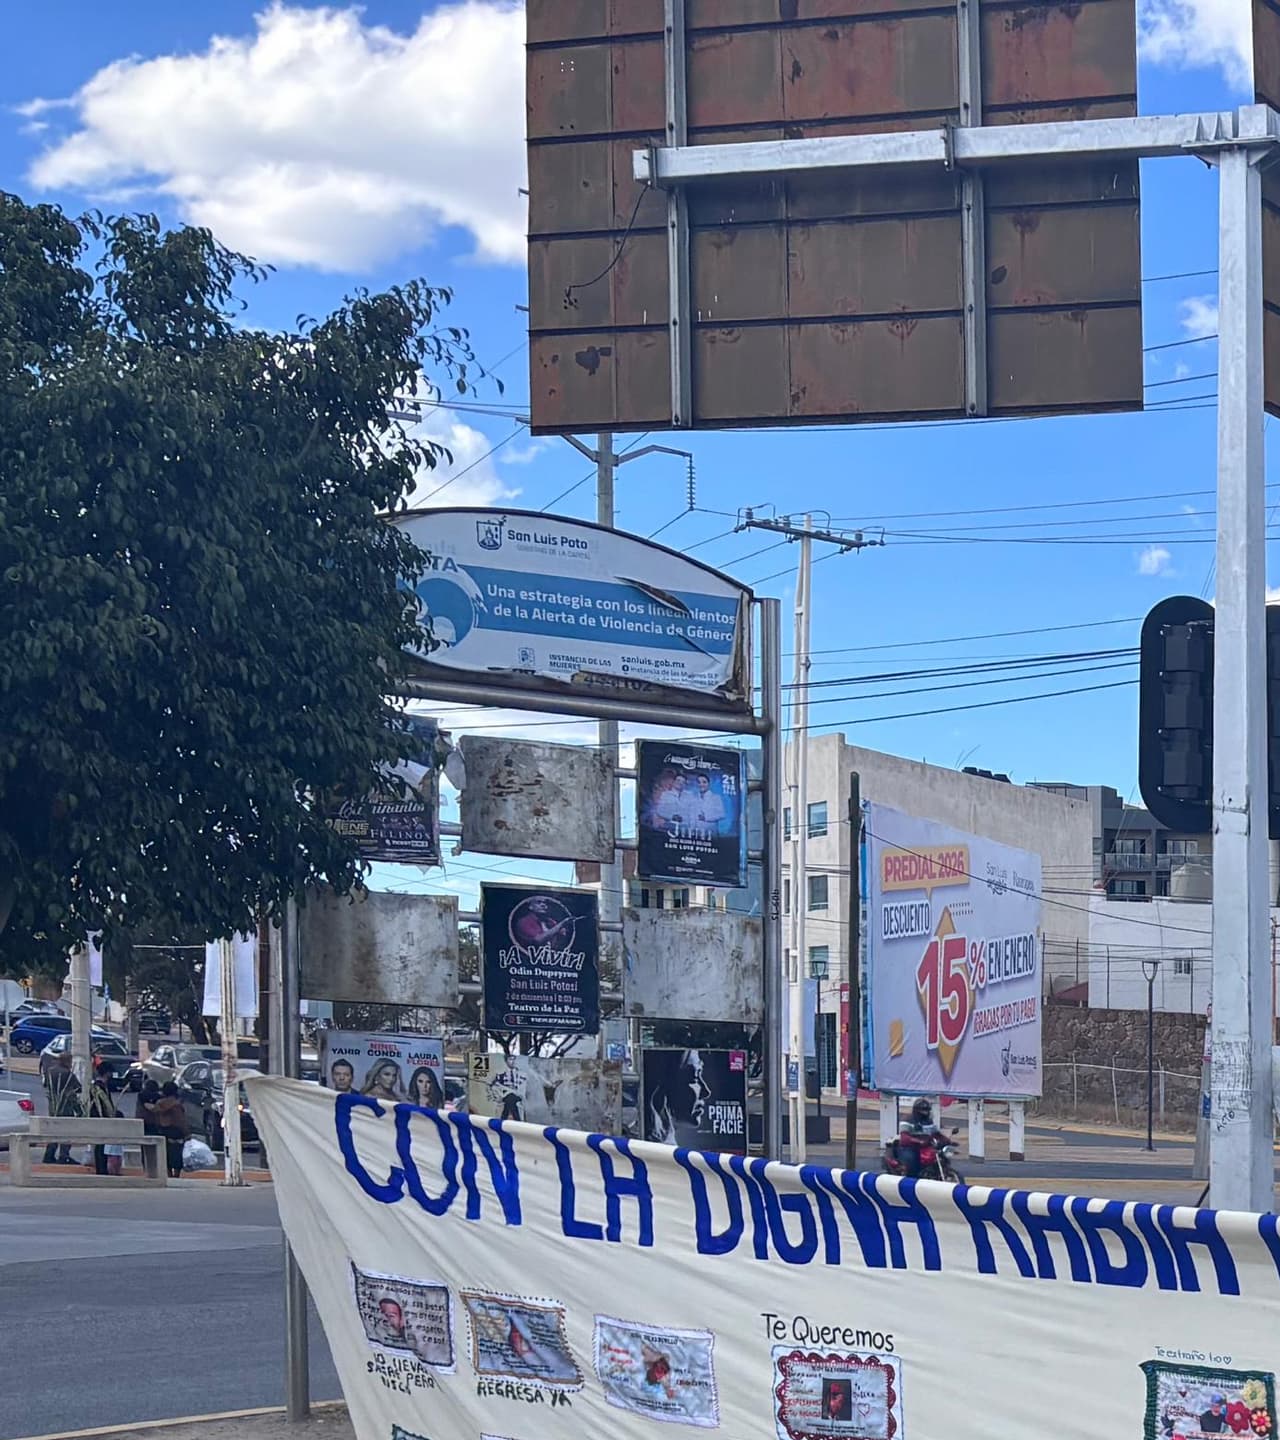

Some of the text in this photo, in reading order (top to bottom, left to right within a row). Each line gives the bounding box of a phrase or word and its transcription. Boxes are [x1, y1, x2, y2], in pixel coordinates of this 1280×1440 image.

[508, 530, 530, 542] San
[534, 533, 557, 546] Luis
[488, 584, 736, 625] Una estrategia con los lineamientos
[495, 604, 733, 641] de la Alerta de Violencia de Género
[549, 654, 587, 664] INSTANCIA
[622, 656, 685, 668] sanluis.gob.mx
[722, 775, 735, 784] 21
[884, 856, 937, 882] PREDIAL
[938, 852, 965, 876] 2026
[883, 902, 930, 936] DESCUENTO
[988, 943, 1001, 980] EN
[1004, 935, 1034, 977] ENERO
[408, 1052, 438, 1060] LAURA
[474, 1057, 489, 1070] 21
[709, 1106, 743, 1120] PRIMA
[713, 1120, 744, 1135] FACIE
[335, 1093, 523, 1226] CON
[542, 1126, 655, 1246] LA
[673, 1148, 943, 1272] DIGNA
[761, 1313, 894, 1351] Te Queremos
[478, 1382, 572, 1407] REGRESA YA
